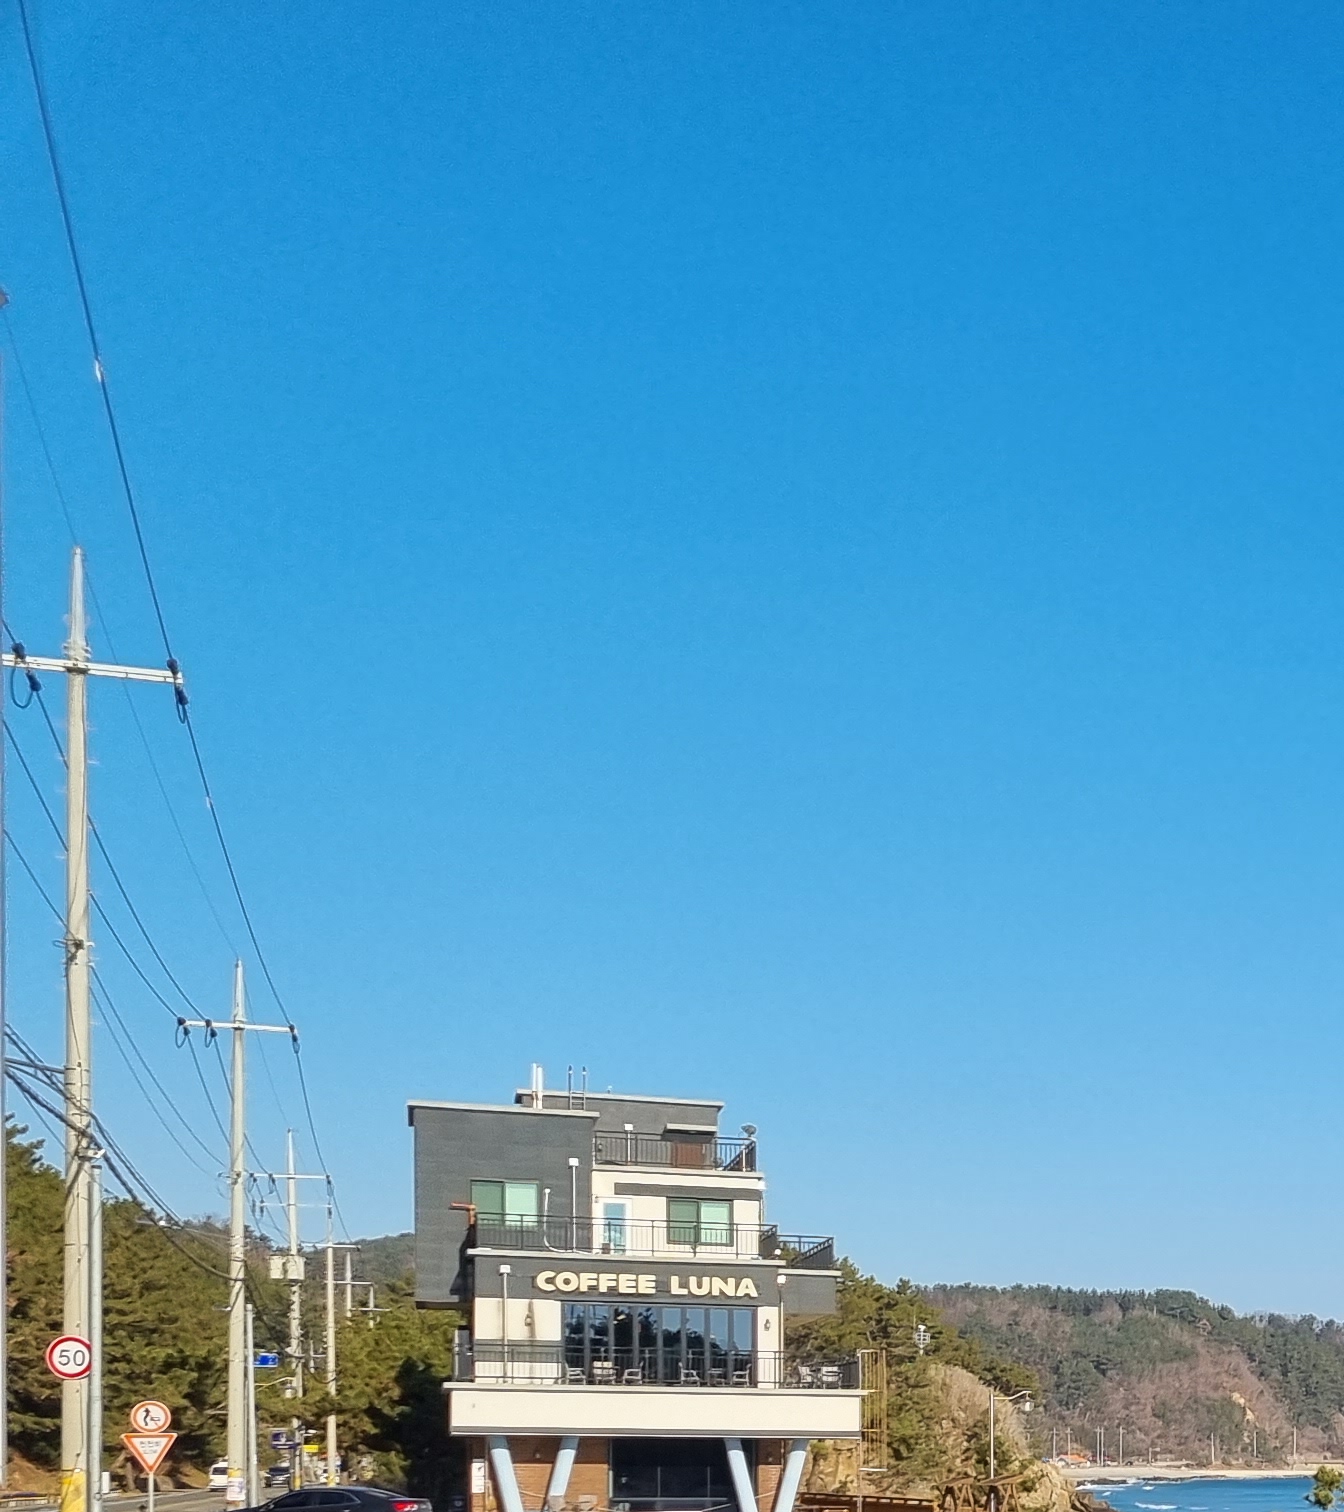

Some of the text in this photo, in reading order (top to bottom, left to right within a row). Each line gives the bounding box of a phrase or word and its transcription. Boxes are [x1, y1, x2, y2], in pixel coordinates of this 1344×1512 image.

[536, 1270, 758, 1298] COFFEE LUNA
[58, 1348, 86, 1367] 50
